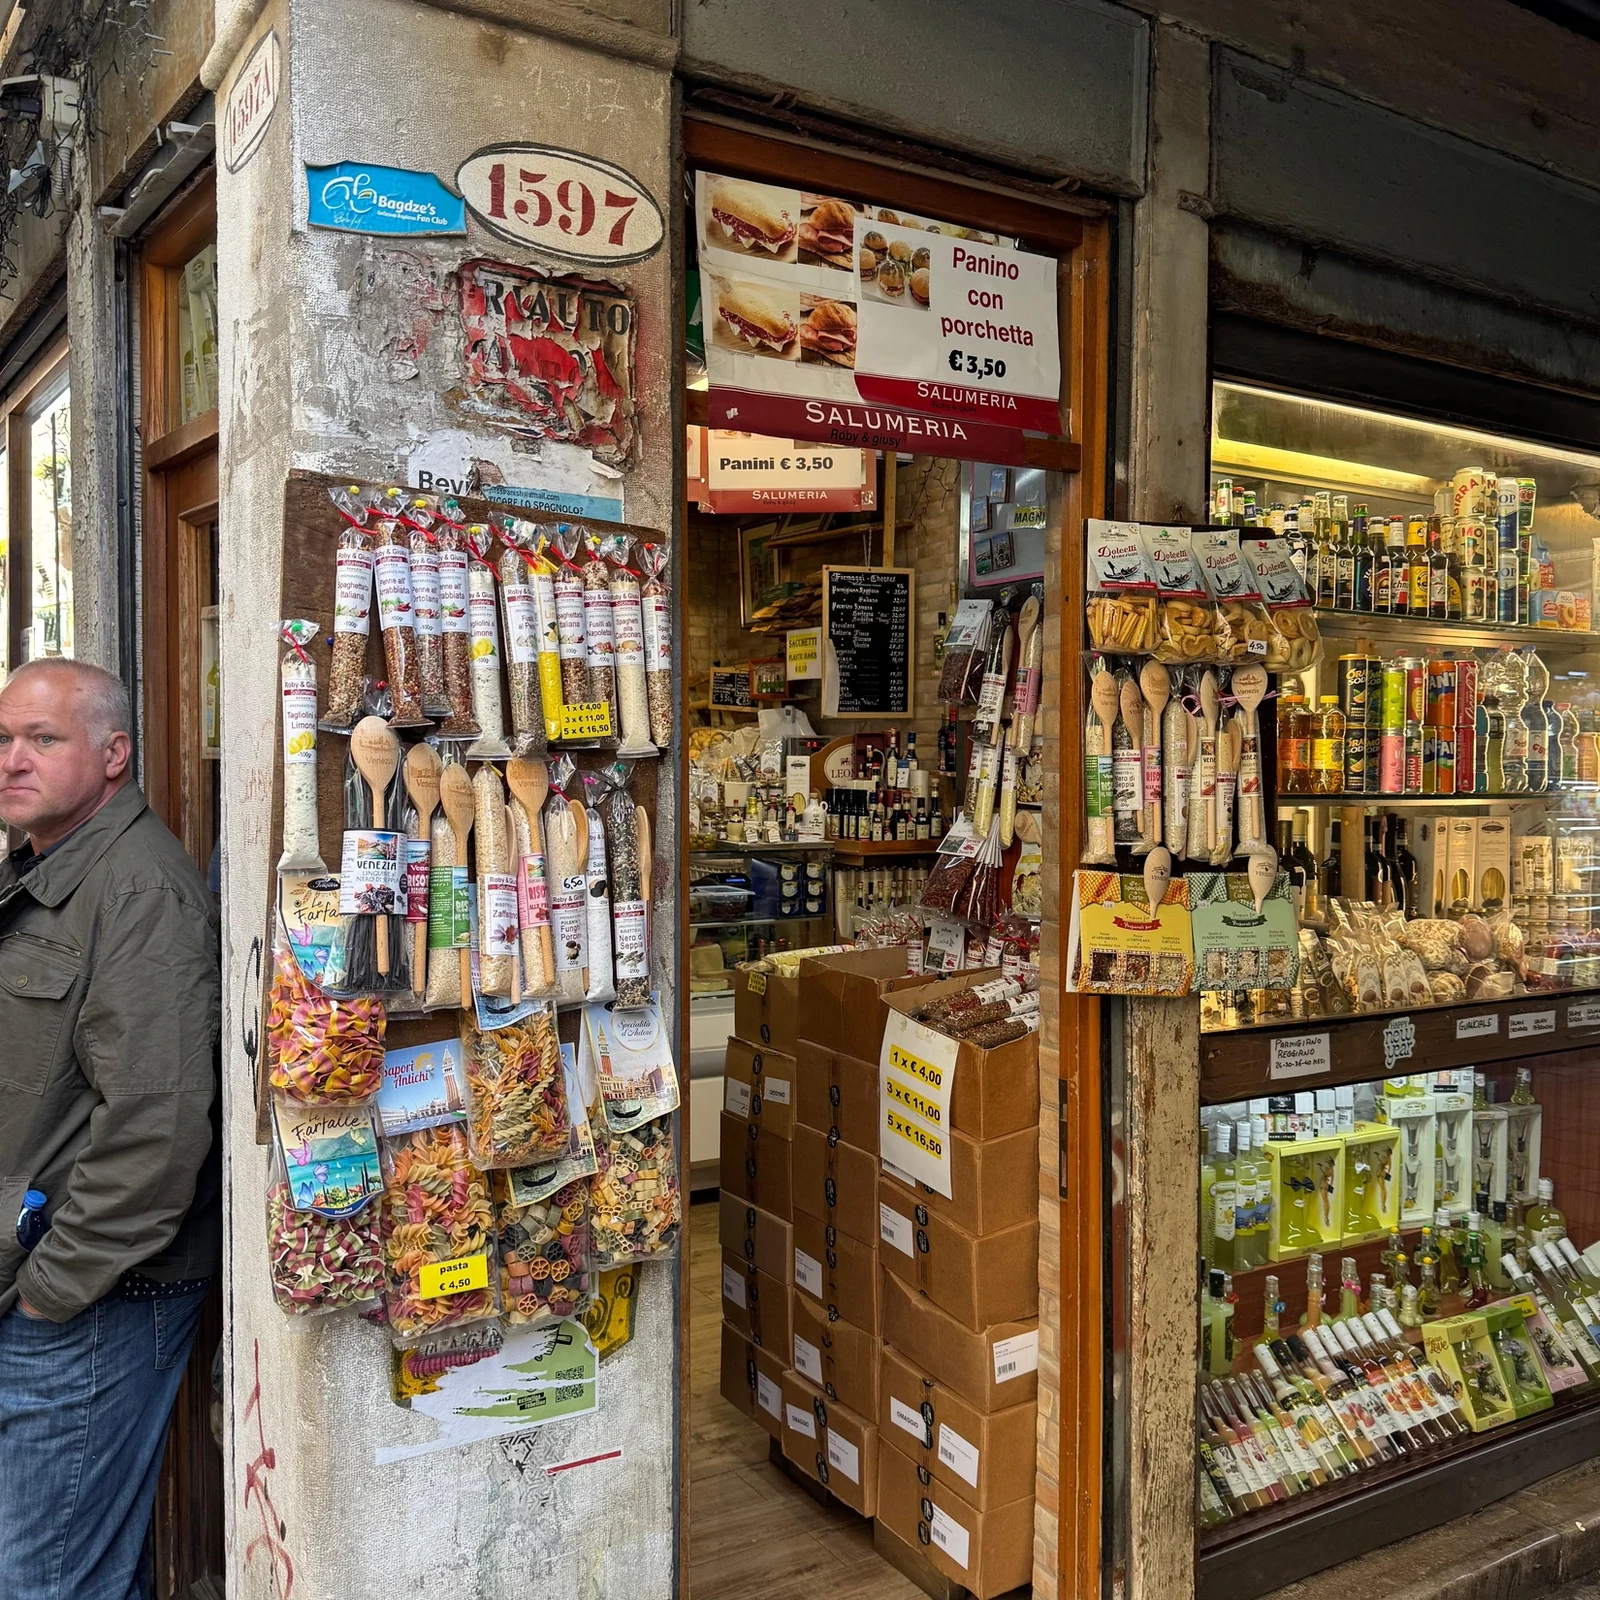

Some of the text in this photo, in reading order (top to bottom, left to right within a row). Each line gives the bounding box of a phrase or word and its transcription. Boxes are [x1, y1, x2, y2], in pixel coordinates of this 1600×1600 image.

[231, 60, 272, 146] 1597A
[378, 196, 437, 216] Bagdze's
[487, 163, 638, 246] 1597
[416, 214, 431, 223] Fan
[431, 216, 448, 226] Club
[952, 246, 1020, 281] Panino
[967, 288, 1004, 311] con
[940, 315, 1034, 347] porchetta
[948, 350, 1007, 380] € 3,50
[916, 381, 1018, 410] SALUMERIA
[805, 402, 968, 441] SALUMERIA
[829, 428, 902, 448] Roby & giusy
[719, 456, 834, 472] Panini € 3,50
[752, 490, 828, 500] SALUMERIA
[533, 501, 584, 515] SPAGNOLO?
[1097, 545, 1138, 558] Dolcetti
[1153, 550, 1188, 562] Dolcetti
[1205, 552, 1238, 569] Dolcetti
[1256, 560, 1288, 576] Dolcetti
[788, 636, 818, 648] SACCHETTI
[585, 703, 602, 711] 4,00
[291, 721, 316, 730] Limone
[585, 713, 605, 723] 11,00
[585, 724, 609, 734] 16,50
[357, 860, 398, 871] VENEZIA
[563, 875, 583, 890] 6,50
[311, 896, 323, 909] Le
[1390, 1021, 1409, 1029] HAPPY
[1385, 1027, 1413, 1045] new
[1275, 1038, 1322, 1051] PARMIGIANO
[1277, 1049, 1315, 1059] REGGIANO
[1386, 1041, 1413, 1066] year
[892, 1051, 942, 1086] 1 x € 4,00
[393, 1069, 429, 1089] Antichi
[886, 1081, 941, 1122] 3 x € 11,00
[308, 1113, 319, 1123] Le
[291, 1115, 362, 1141] Farfalle
[887, 1113, 942, 1156] 5 x € 16,50
[440, 1262, 469, 1275] pasta
[439, 1278, 471, 1291] € 4,50
